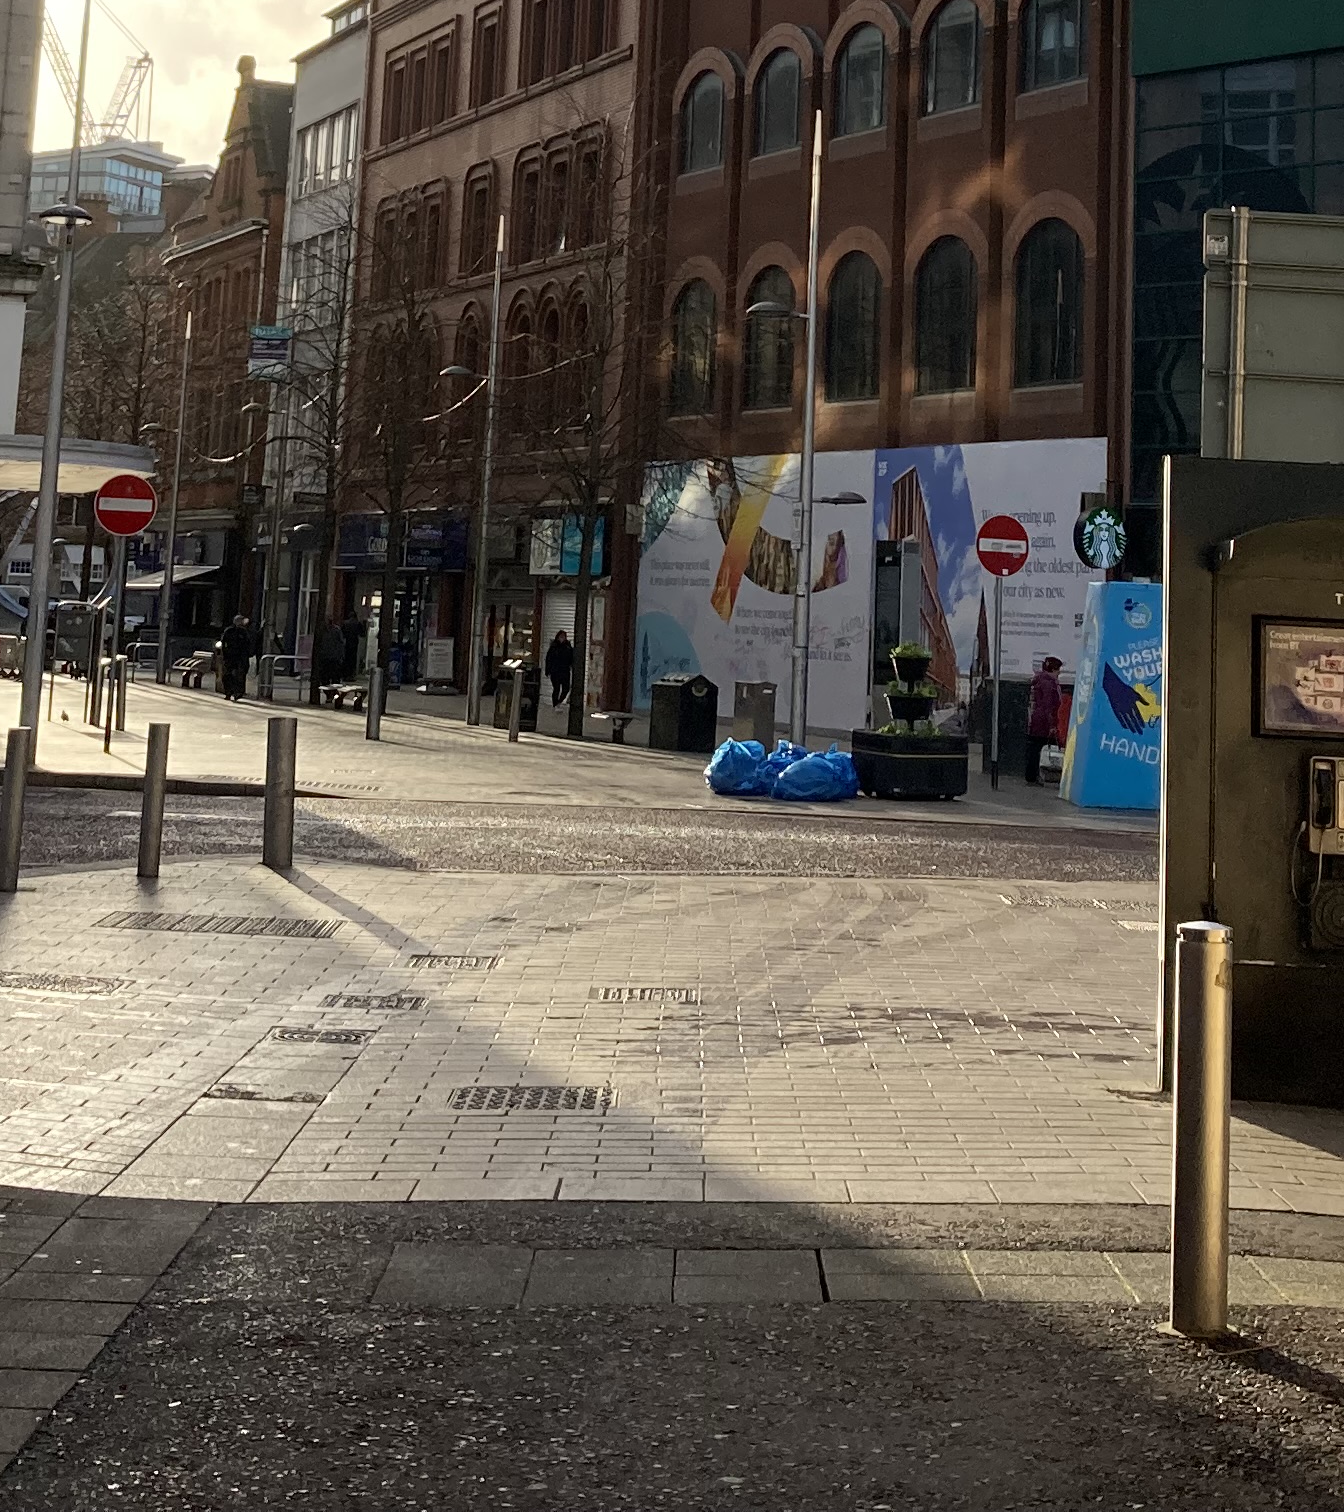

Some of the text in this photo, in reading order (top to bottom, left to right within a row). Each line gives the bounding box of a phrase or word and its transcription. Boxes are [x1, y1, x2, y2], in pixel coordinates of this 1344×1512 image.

[1033, 560, 1047, 574] the
[1049, 560, 1074, 575] oldest
[1018, 584, 1032, 600] city
[1113, 645, 1163, 670] WASH
